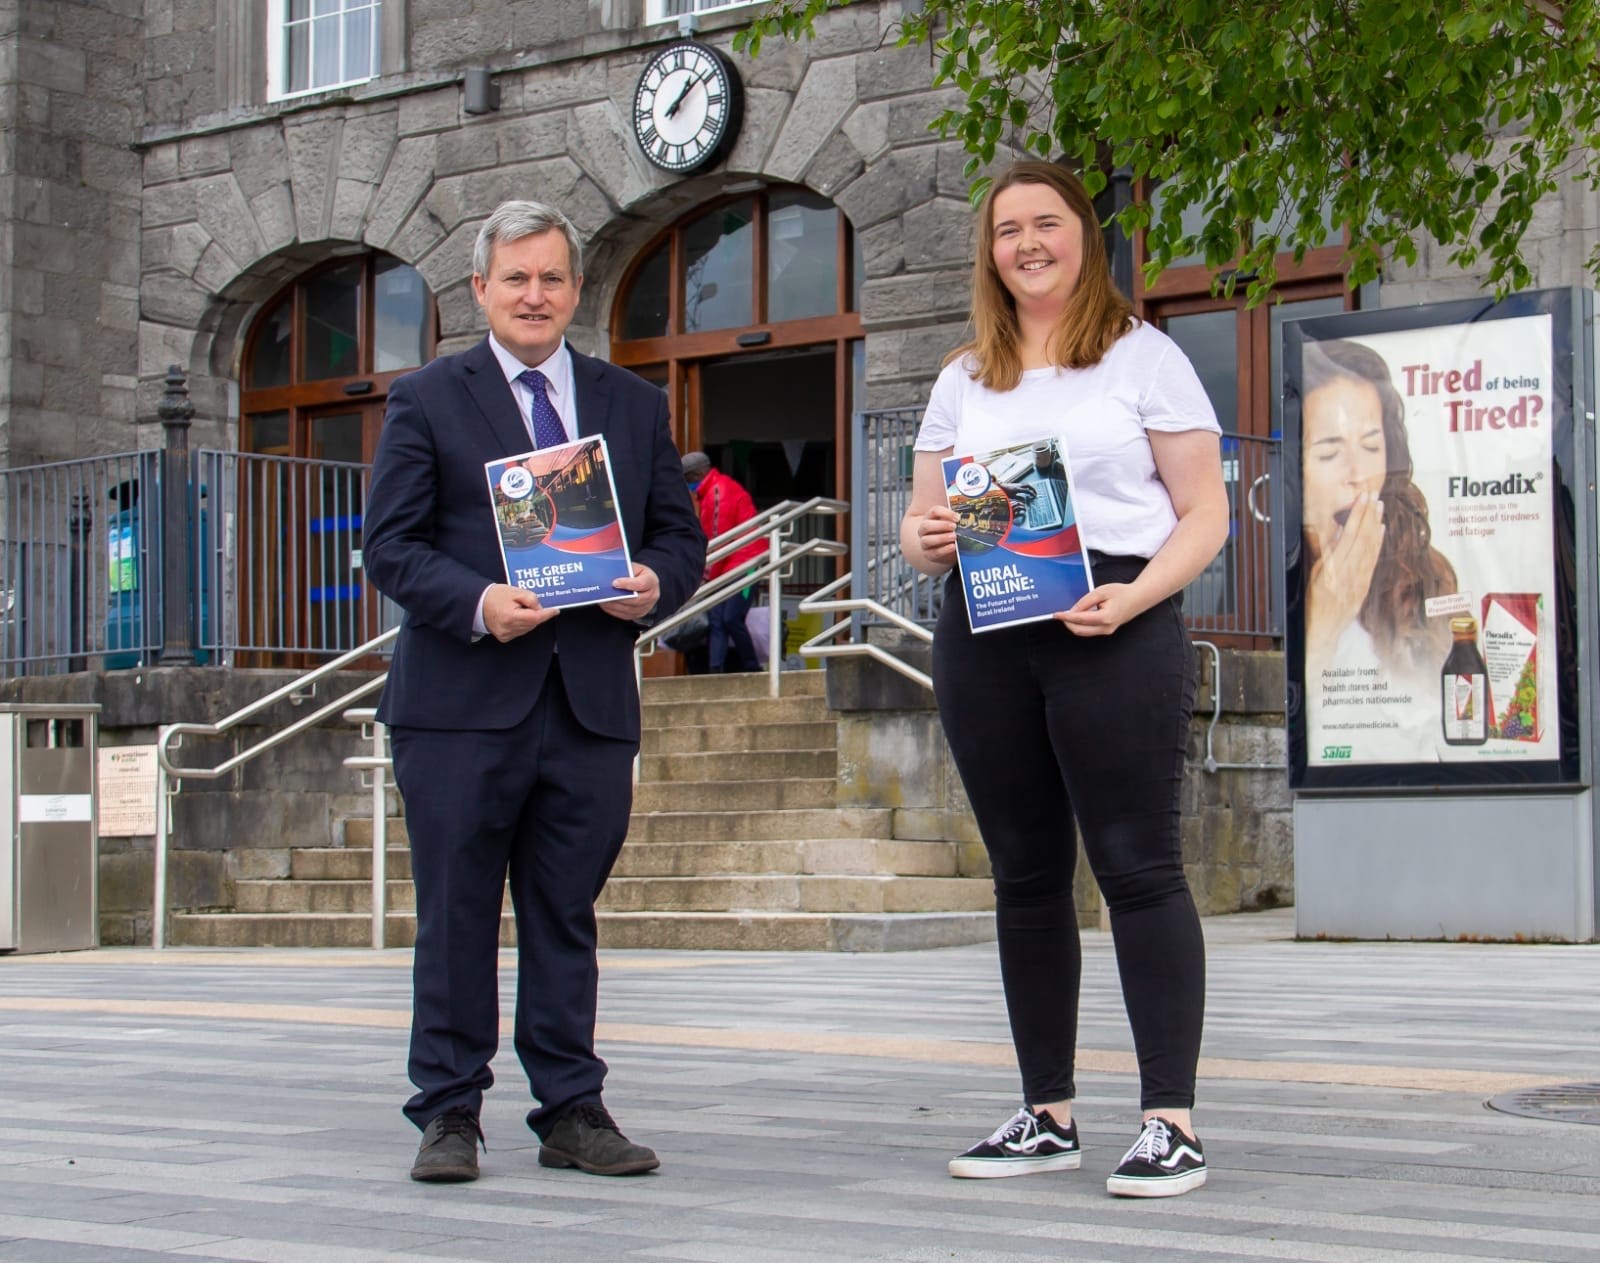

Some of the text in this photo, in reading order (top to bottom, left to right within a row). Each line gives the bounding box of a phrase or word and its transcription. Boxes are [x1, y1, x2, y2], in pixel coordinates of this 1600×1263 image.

[1401, 359, 1540, 396] Tired of being
[1443, 395, 1544, 432] Tired?
[1448, 512, 1540, 524] reduction of tiredness
[1448, 527, 1495, 537] and fatigue
[515, 561, 584, 579] THE GREEN
[970, 564, 1022, 586] RURAL
[517, 575, 565, 590] ROUTE:
[572, 585, 601, 593] Transport
[973, 576, 1035, 599] ONLINE:
[988, 599, 1008, 608] Future
[977, 604, 1015, 617] Rural Ireland
[1321, 668, 1355, 677] Availab
[1322, 683, 1346, 692] health
[1372, 680, 1388, 691] and
[1322, 694, 1413, 708] pharmacies nationwide
